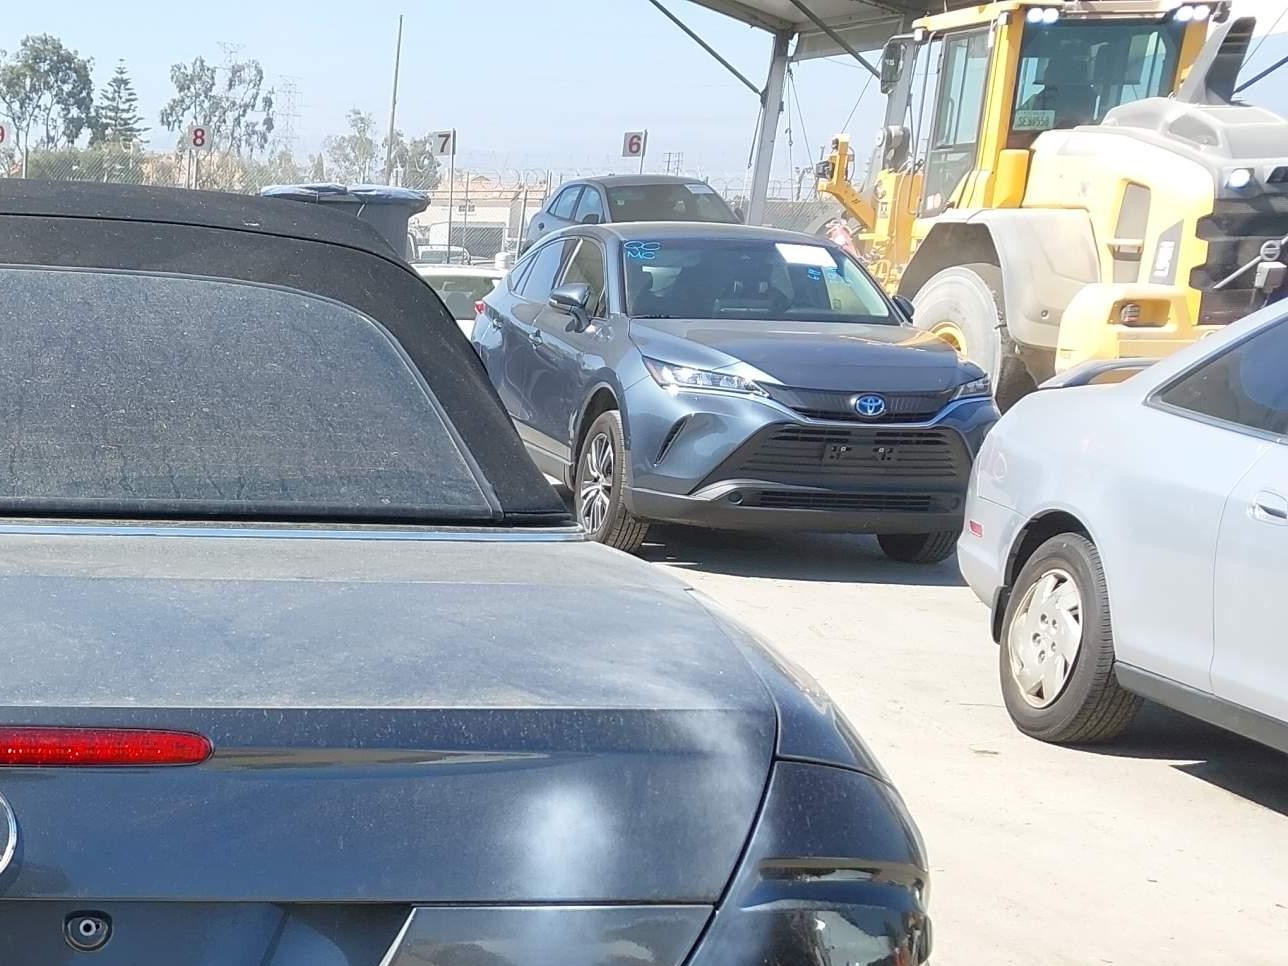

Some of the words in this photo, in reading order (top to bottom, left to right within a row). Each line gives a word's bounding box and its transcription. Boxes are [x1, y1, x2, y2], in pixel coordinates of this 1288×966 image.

[192, 127, 206, 148] 8
[437, 133, 451, 153] 7
[628, 134, 642, 154] 6
